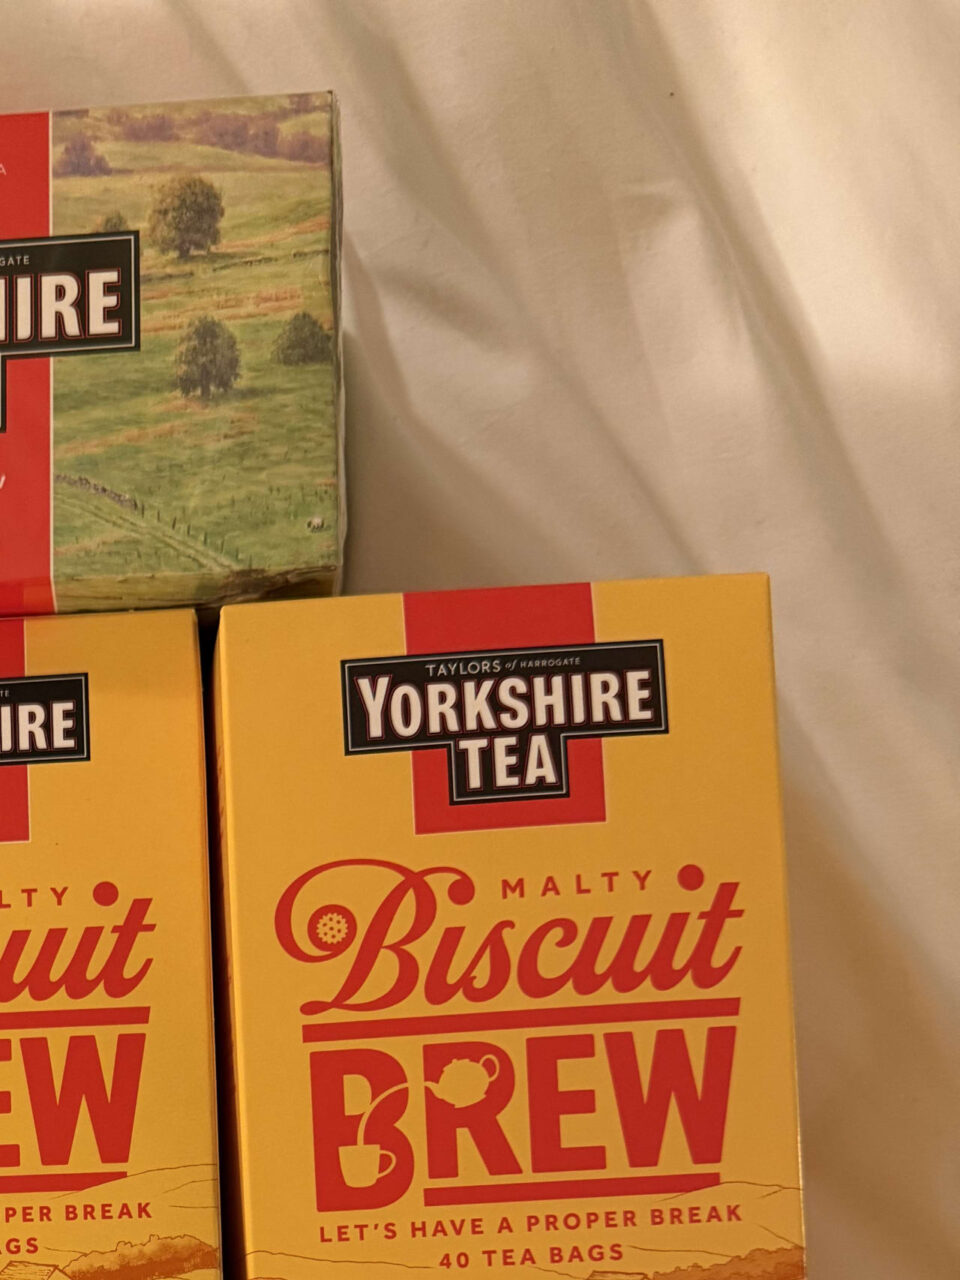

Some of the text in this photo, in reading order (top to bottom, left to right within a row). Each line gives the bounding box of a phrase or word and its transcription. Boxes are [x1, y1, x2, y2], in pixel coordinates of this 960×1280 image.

[425, 659, 501, 677] TAYLORS
[520, 657, 581, 668] HARROGATE
[356, 669, 653, 739] YORKSHIRE
[457, 733, 558, 790] TEA
[501, 869, 651, 899] MALTY
[273, 858, 744, 1016] Biscuit
[309, 1025, 738, 1213] BREW
[64, 1202, 152, 1222] BREAK
[320, 1206, 741, 1243] LET'S HAVE A PROPER BREAK
[439, 1243, 623, 1269] 40 TEA BAGS
